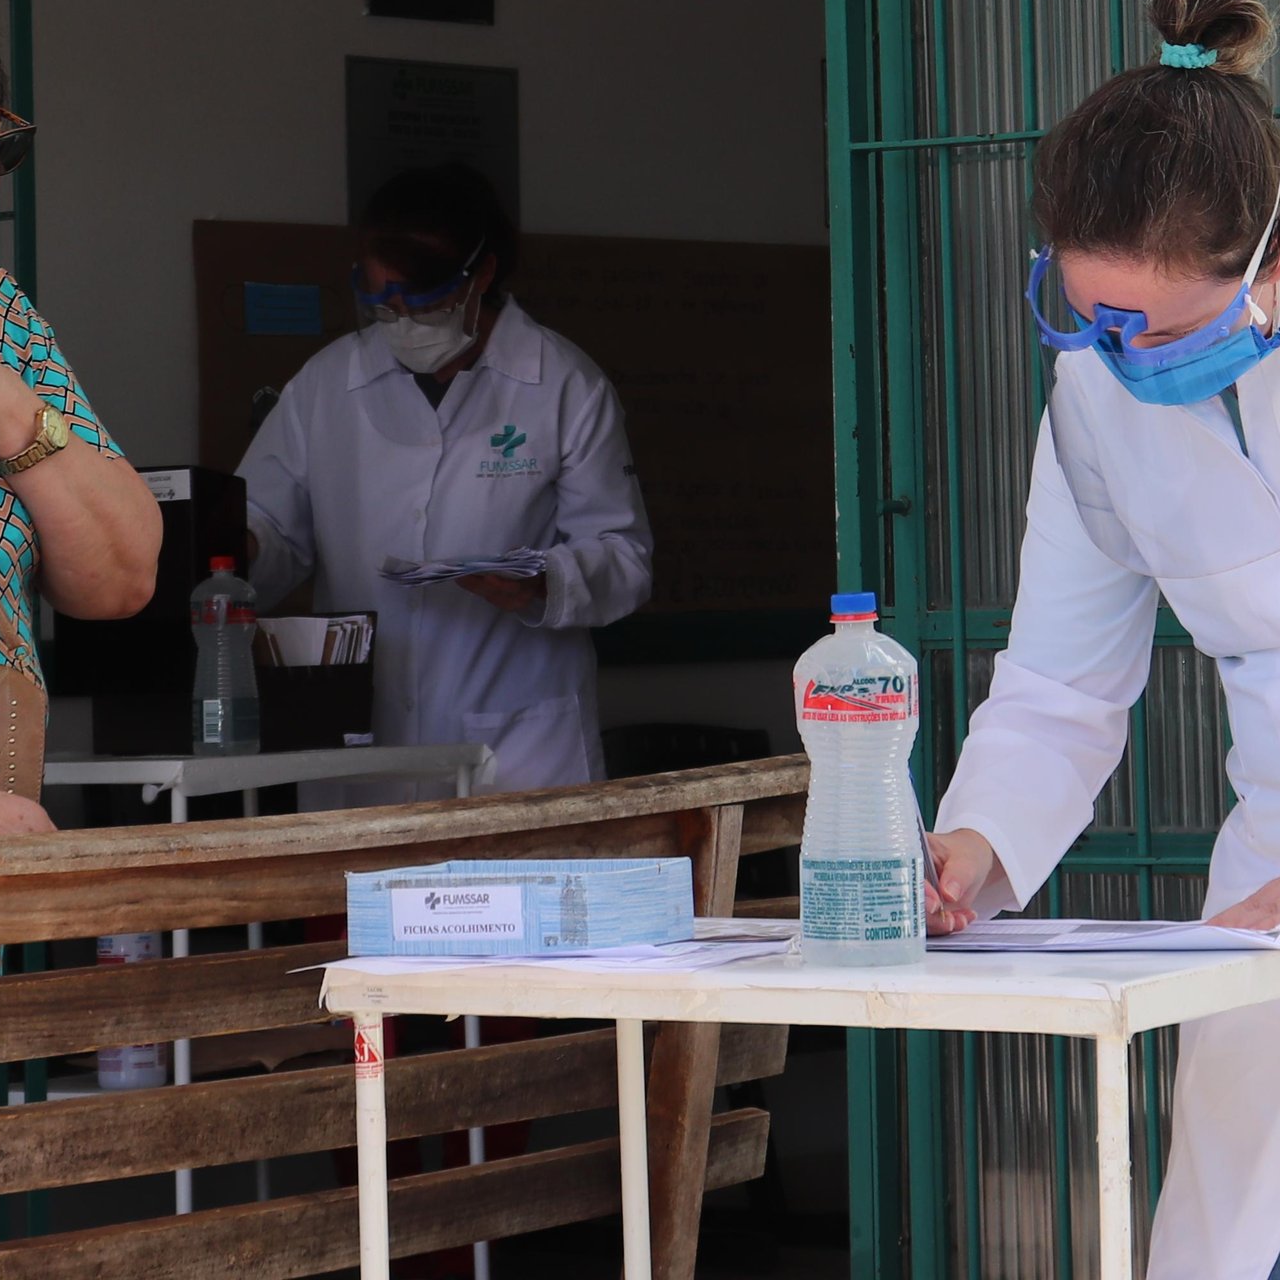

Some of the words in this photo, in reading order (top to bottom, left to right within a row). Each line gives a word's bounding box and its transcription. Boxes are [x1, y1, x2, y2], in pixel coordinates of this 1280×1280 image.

[878, 675, 905, 694] 70
[443, 893, 490, 904] FUMSSAR
[403, 924, 439, 935] FICHAS
[441, 923, 516, 934] ACOLHIMENTO
[865, 923, 902, 941] CONTEÚDO
